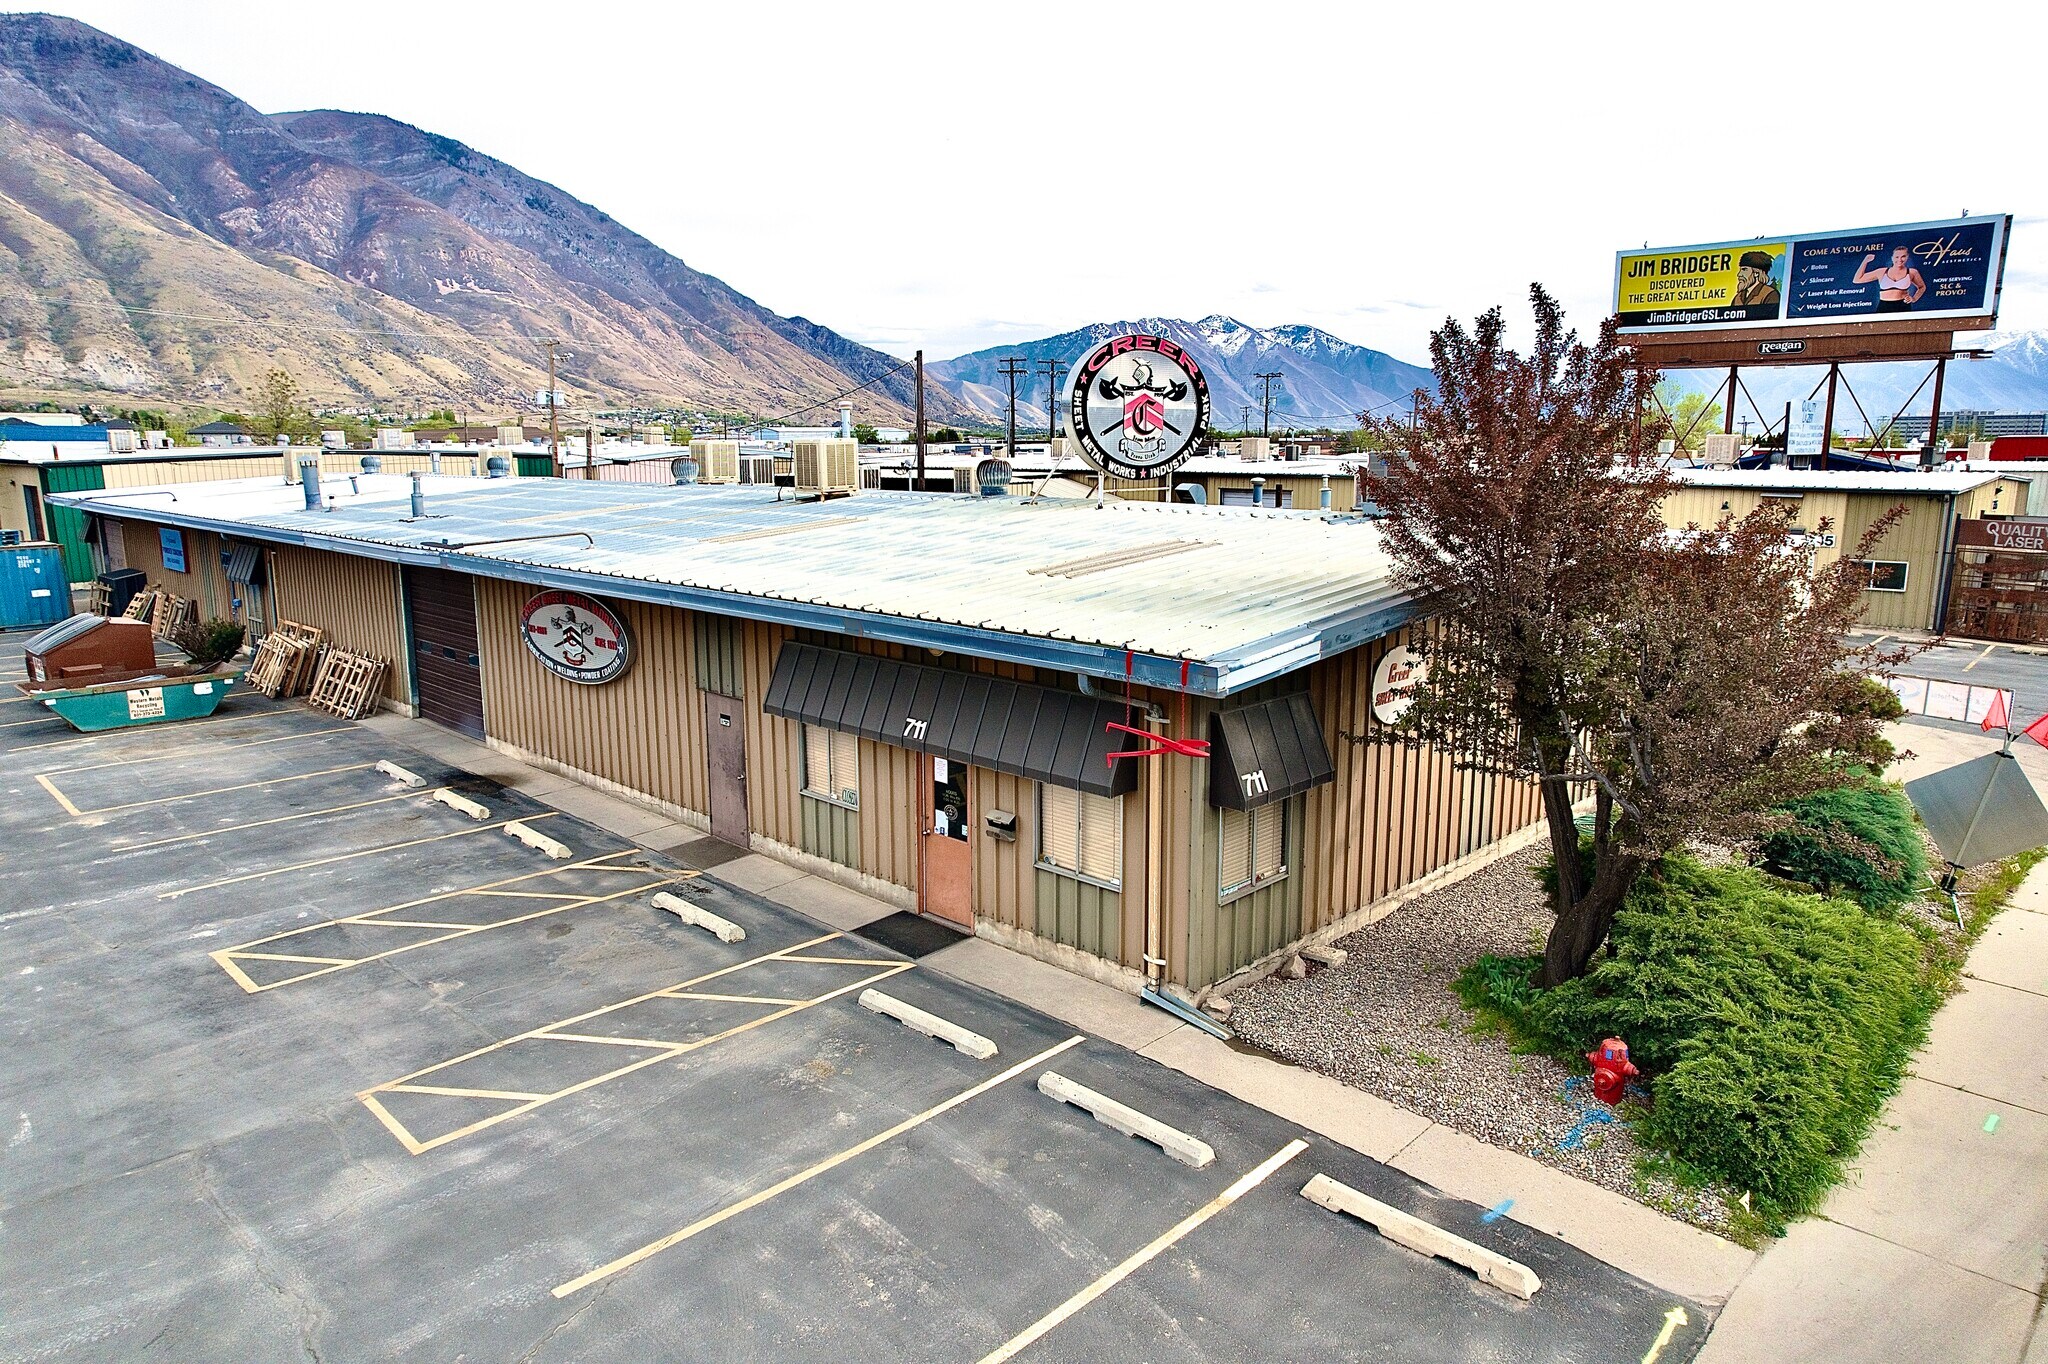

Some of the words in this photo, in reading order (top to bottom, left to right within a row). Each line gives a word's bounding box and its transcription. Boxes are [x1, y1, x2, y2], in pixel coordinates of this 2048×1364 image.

[1803, 248, 1828, 257] COME
[1830, 246, 1841, 255] AS
[1843, 245, 1863, 254] YOU
[1864, 243, 1884, 252] ARE!
[1628, 259, 1655, 278] JIM
[1660, 253, 1732, 276] BRIDGER
[1649, 277, 1705, 291] DISCOVERED
[1809, 276, 1835, 284] Skincare
[1948, 275, 1973, 283] SERVING
[1628, 293, 1645, 304] THE
[1646, 292, 1674, 303] GREAT
[1677, 290, 1699, 301] SALT
[1702, 288, 1727, 300] LAKE
[1807, 289, 1823, 297] Laser
[1824, 288, 1838, 296] Hair
[1838, 287, 1866, 296] Removal
[1935, 289, 1967, 297] PROVO!
[1806, 303, 1828, 311] Weight
[1842, 300, 1872, 310] Injections
[1646, 308, 1747, 325] JimBridgerGSL.com
[1761, 341, 1802, 353] Reagan
[1087, 335, 1199, 380] CREER
[1073, 389, 1084, 431] SHEET
[1081, 434, 1104, 466] METAL
[1107, 460, 1136, 479] WORKS
[1149, 436, 1203, 478] INDUSTRIAL
[1199, 393, 1210, 430] PARK
[1994, 535, 2044, 550] LASER
[566, 593, 590, 611] METAL
[592, 602, 620, 639] WORKS
[556, 664, 579, 679] WELDING
[580, 670, 601, 680] POWDER
[601, 656, 621, 678] COATING
[903, 717, 928, 740] 711
[1240, 769, 1269, 797] 711
